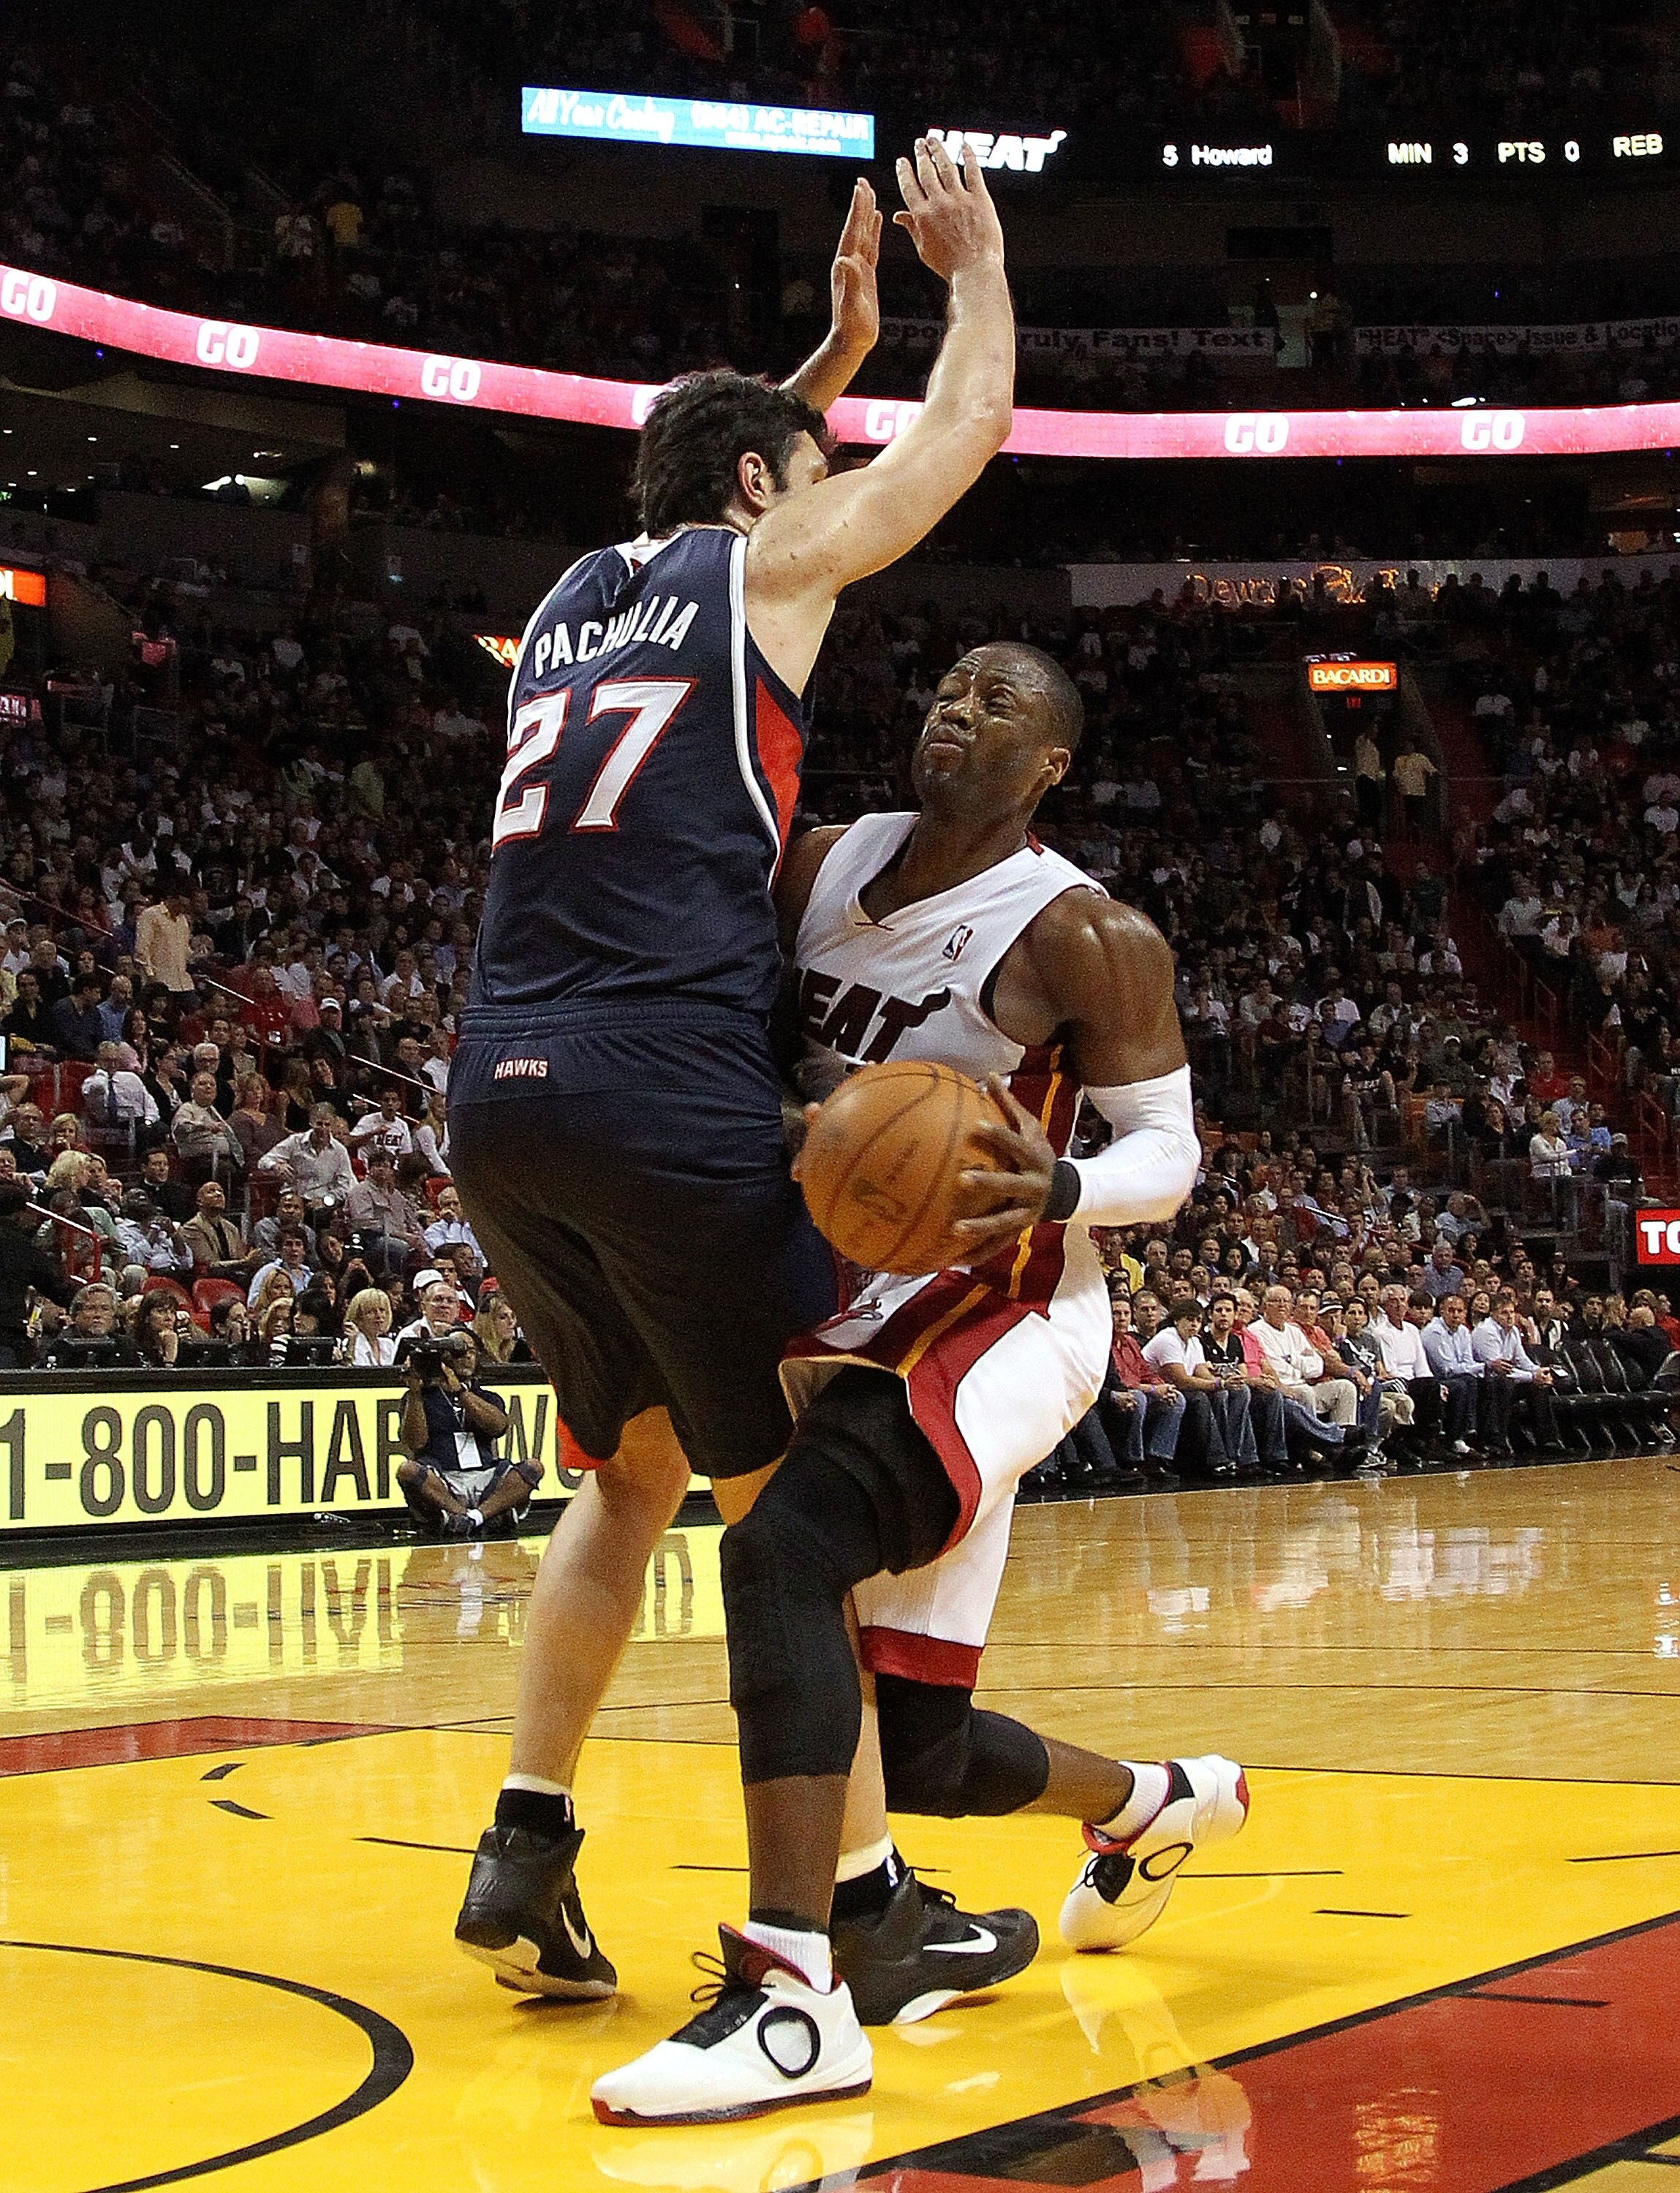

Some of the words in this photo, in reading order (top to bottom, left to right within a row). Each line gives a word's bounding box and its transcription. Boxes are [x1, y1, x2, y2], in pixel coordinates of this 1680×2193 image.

[1192, 145, 1273, 166] Howard
[1388, 143, 1432, 164] MIN
[1453, 143, 1469, 164] 3
[1497, 142, 1545, 163] PTS
[1613, 133, 1663, 157] REB
[1, 268, 57, 322] GO
[197, 320, 260, 368] GO
[422, 354, 481, 401] GO
[1225, 414, 1290, 452] GO
[1461, 411, 1526, 450] GO
[534, 595, 700, 679] PACHULIA
[1313, 668, 1390, 685] BACARDI
[493, 675, 697, 849] 27
[796, 967, 950, 1064] EAT
[494, 1058, 548, 1080] HAWKS
